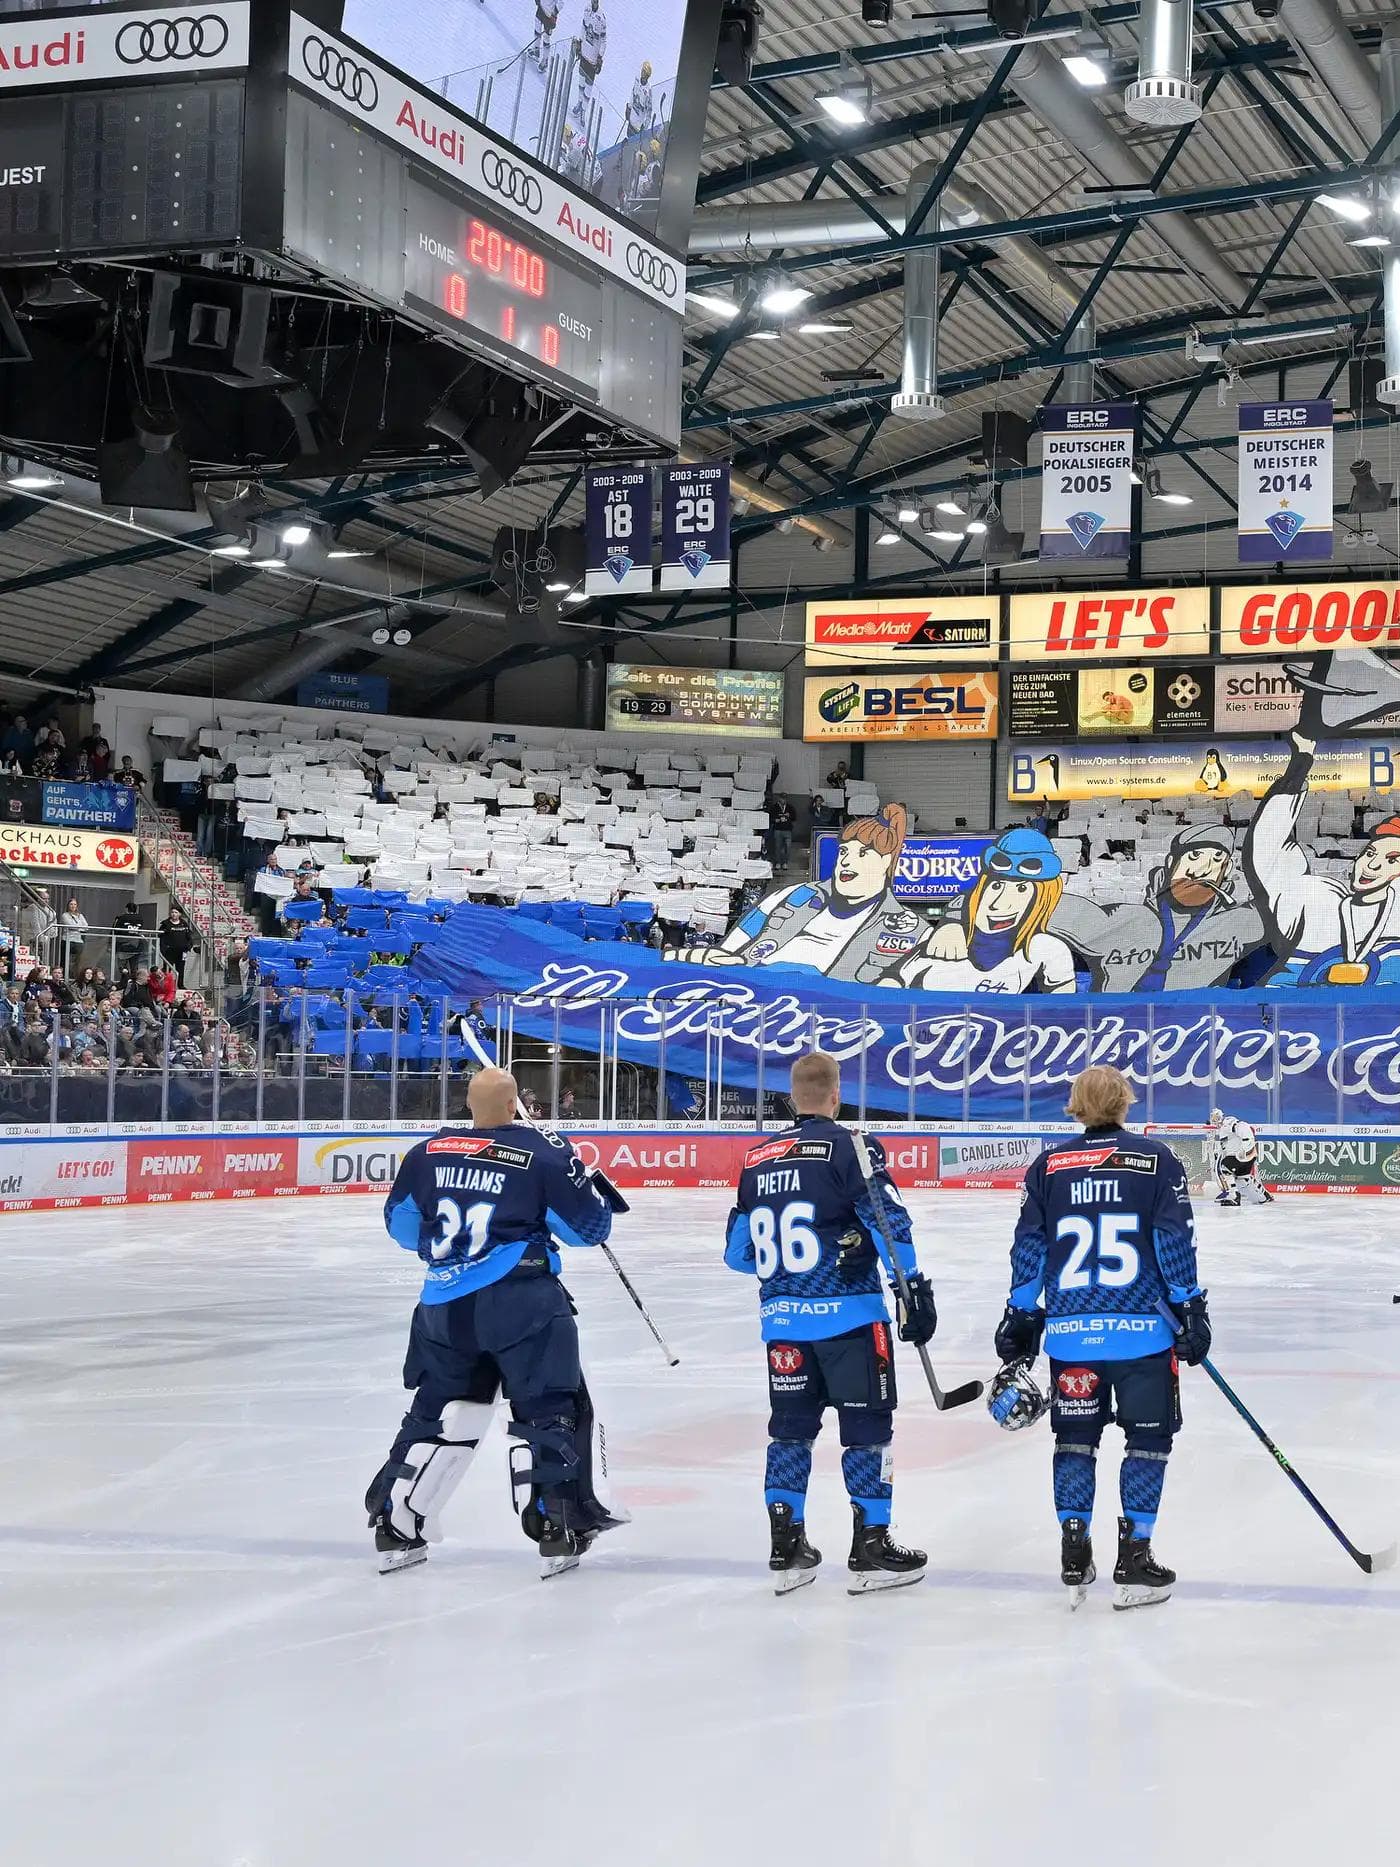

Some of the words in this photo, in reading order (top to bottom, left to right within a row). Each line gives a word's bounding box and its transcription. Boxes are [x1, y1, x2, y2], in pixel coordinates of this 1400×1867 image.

[395, 100, 466, 166] Audi
[556, 202, 613, 258] Audi
[419, 233, 455, 265] HOME
[449, 274, 467, 318] 0
[503, 306, 514, 341] 1
[558, 313, 593, 343] GUEST
[1066, 410, 1109, 422] ERC
[1263, 408, 1307, 421] ERC
[1048, 440, 1126, 453] DEUTSCHER
[1246, 438, 1326, 453] DEUTSCHER
[1043, 457, 1131, 471] POKALSIEGER
[1253, 455, 1318, 470] MEISTER
[678, 484, 713, 498] WAITE
[1060, 475, 1112, 494] 2005
[1258, 474, 1313, 494] 2014
[607, 489, 629, 503] AST
[603, 503, 633, 539] 18
[675, 498, 715, 533] 29
[1044, 596, 1176, 652] LET'S
[944, 627, 987, 641] SATURN
[329, 674, 359, 685] BLUE
[613, 670, 652, 684] Zeit
[657, 673, 685, 686] für
[690, 675, 717, 687] die
[1012, 674, 1028, 682] DER
[1028, 673, 1072, 682] EINFACHSTE
[1012, 682, 1029, 690] WEG
[1030, 682, 1047, 690] ZUM
[679, 691, 780, 703] STRÖHMER
[823, 684, 855, 709] SYSTEM
[864, 686, 986, 716] BESL
[1012, 690, 1038, 699] NEUEN
[1039, 690, 1055, 698] BAD
[314, 696, 370, 710] PANTHERS
[679, 701, 779, 712] COMPUTER
[837, 698, 855, 714] LIFT
[1225, 702, 1246, 712] Kies
[1254, 702, 1290, 711] Erdbau
[683, 708, 775, 720] SYSTEME
[1166, 711, 1202, 719] elements
[1119, 756, 1147, 766] Source
[1147, 755, 1194, 767] Consulting,
[1226, 753, 1262, 764] Training,
[46, 785, 66, 795] AUF
[46, 796, 82, 806] GEHT'S,
[46, 807, 117, 823] PANTHER!
[1, 829, 82, 848] CKHAUS
[0, 846, 82, 866] ackner
[881, 937, 909, 951] ZSC
[886, 1012, 1322, 1091] Deutscher
[608, 1144, 697, 1168] Audi
[961, 1143, 1005, 1162] CANDLE
[57, 1161, 90, 1179] LET'S
[92, 1160, 115, 1177] GO!
[966, 1155, 1030, 1180] original
[435, 1166, 506, 1195] WILLIAMS
[757, 1168, 801, 1197] PIETTA
[1071, 1177, 1123, 1205] HÜTTL
[749, 1201, 821, 1280] 86
[1056, 1212, 1140, 1291] 25
